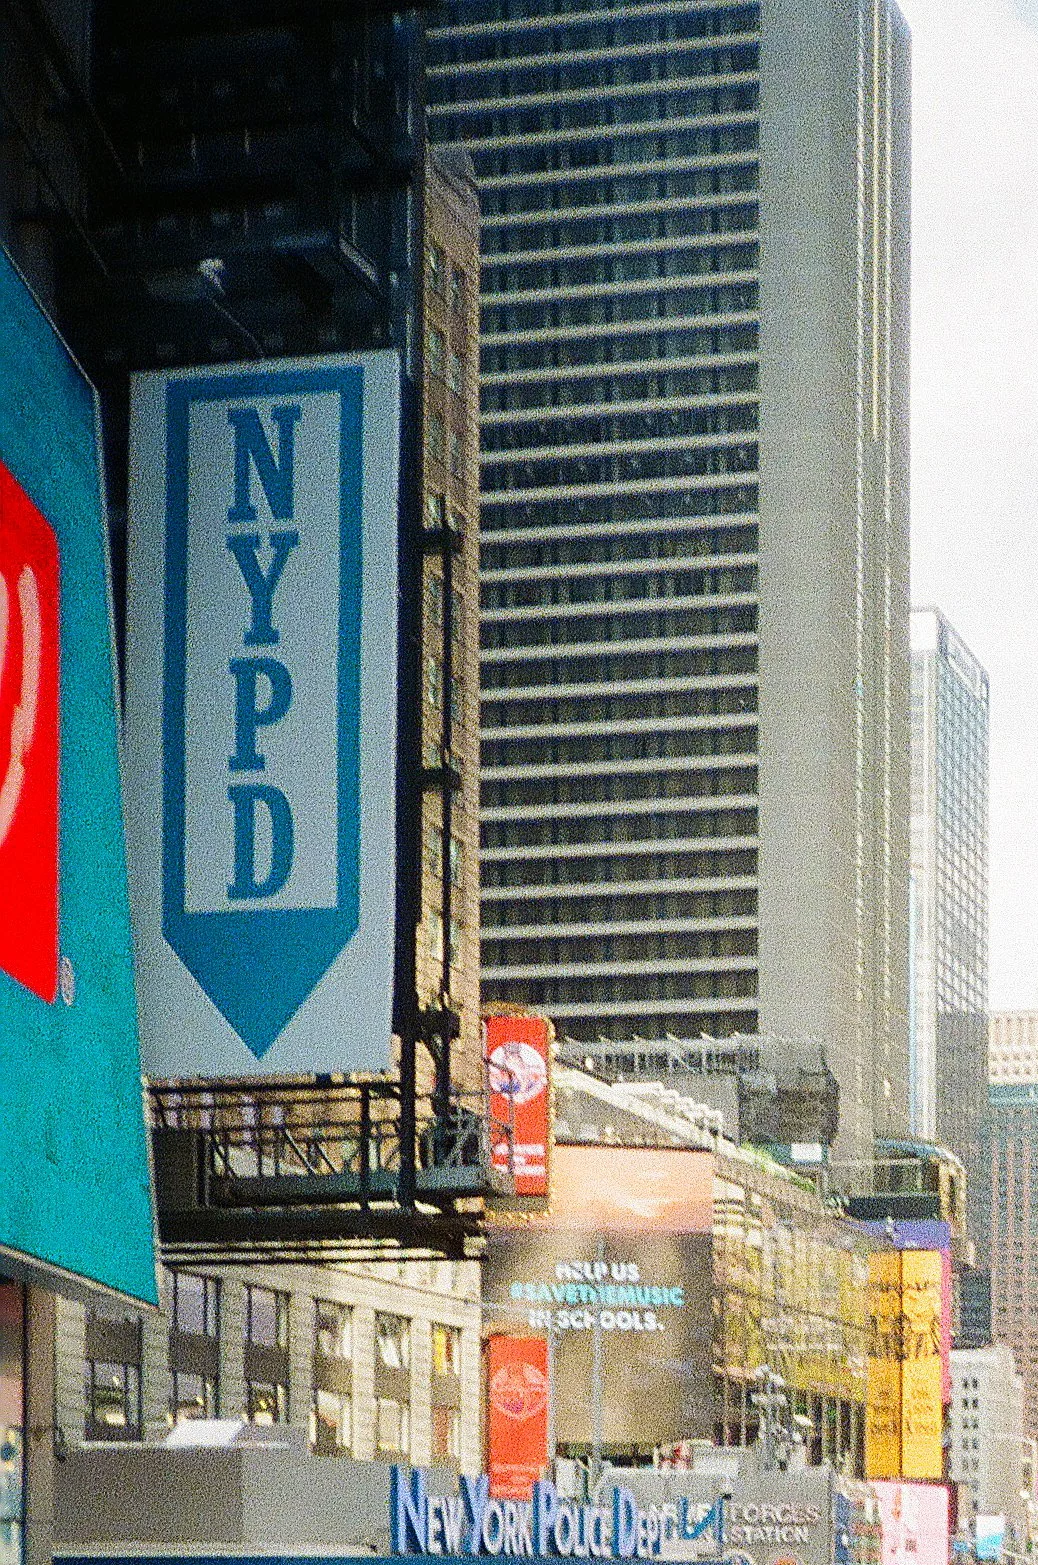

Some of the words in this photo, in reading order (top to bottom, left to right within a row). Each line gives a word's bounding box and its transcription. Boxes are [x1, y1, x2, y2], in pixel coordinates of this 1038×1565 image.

[226, 404, 299, 901] NYPD
[611, 1262, 640, 1282] US
[389, 1465, 464, 1557] NEW
[459, 1473, 533, 1557] YORK
[533, 1480, 612, 1558] POLICE
[730, 1502, 823, 1526] FORCES
[730, 1525, 811, 1545] STATION
